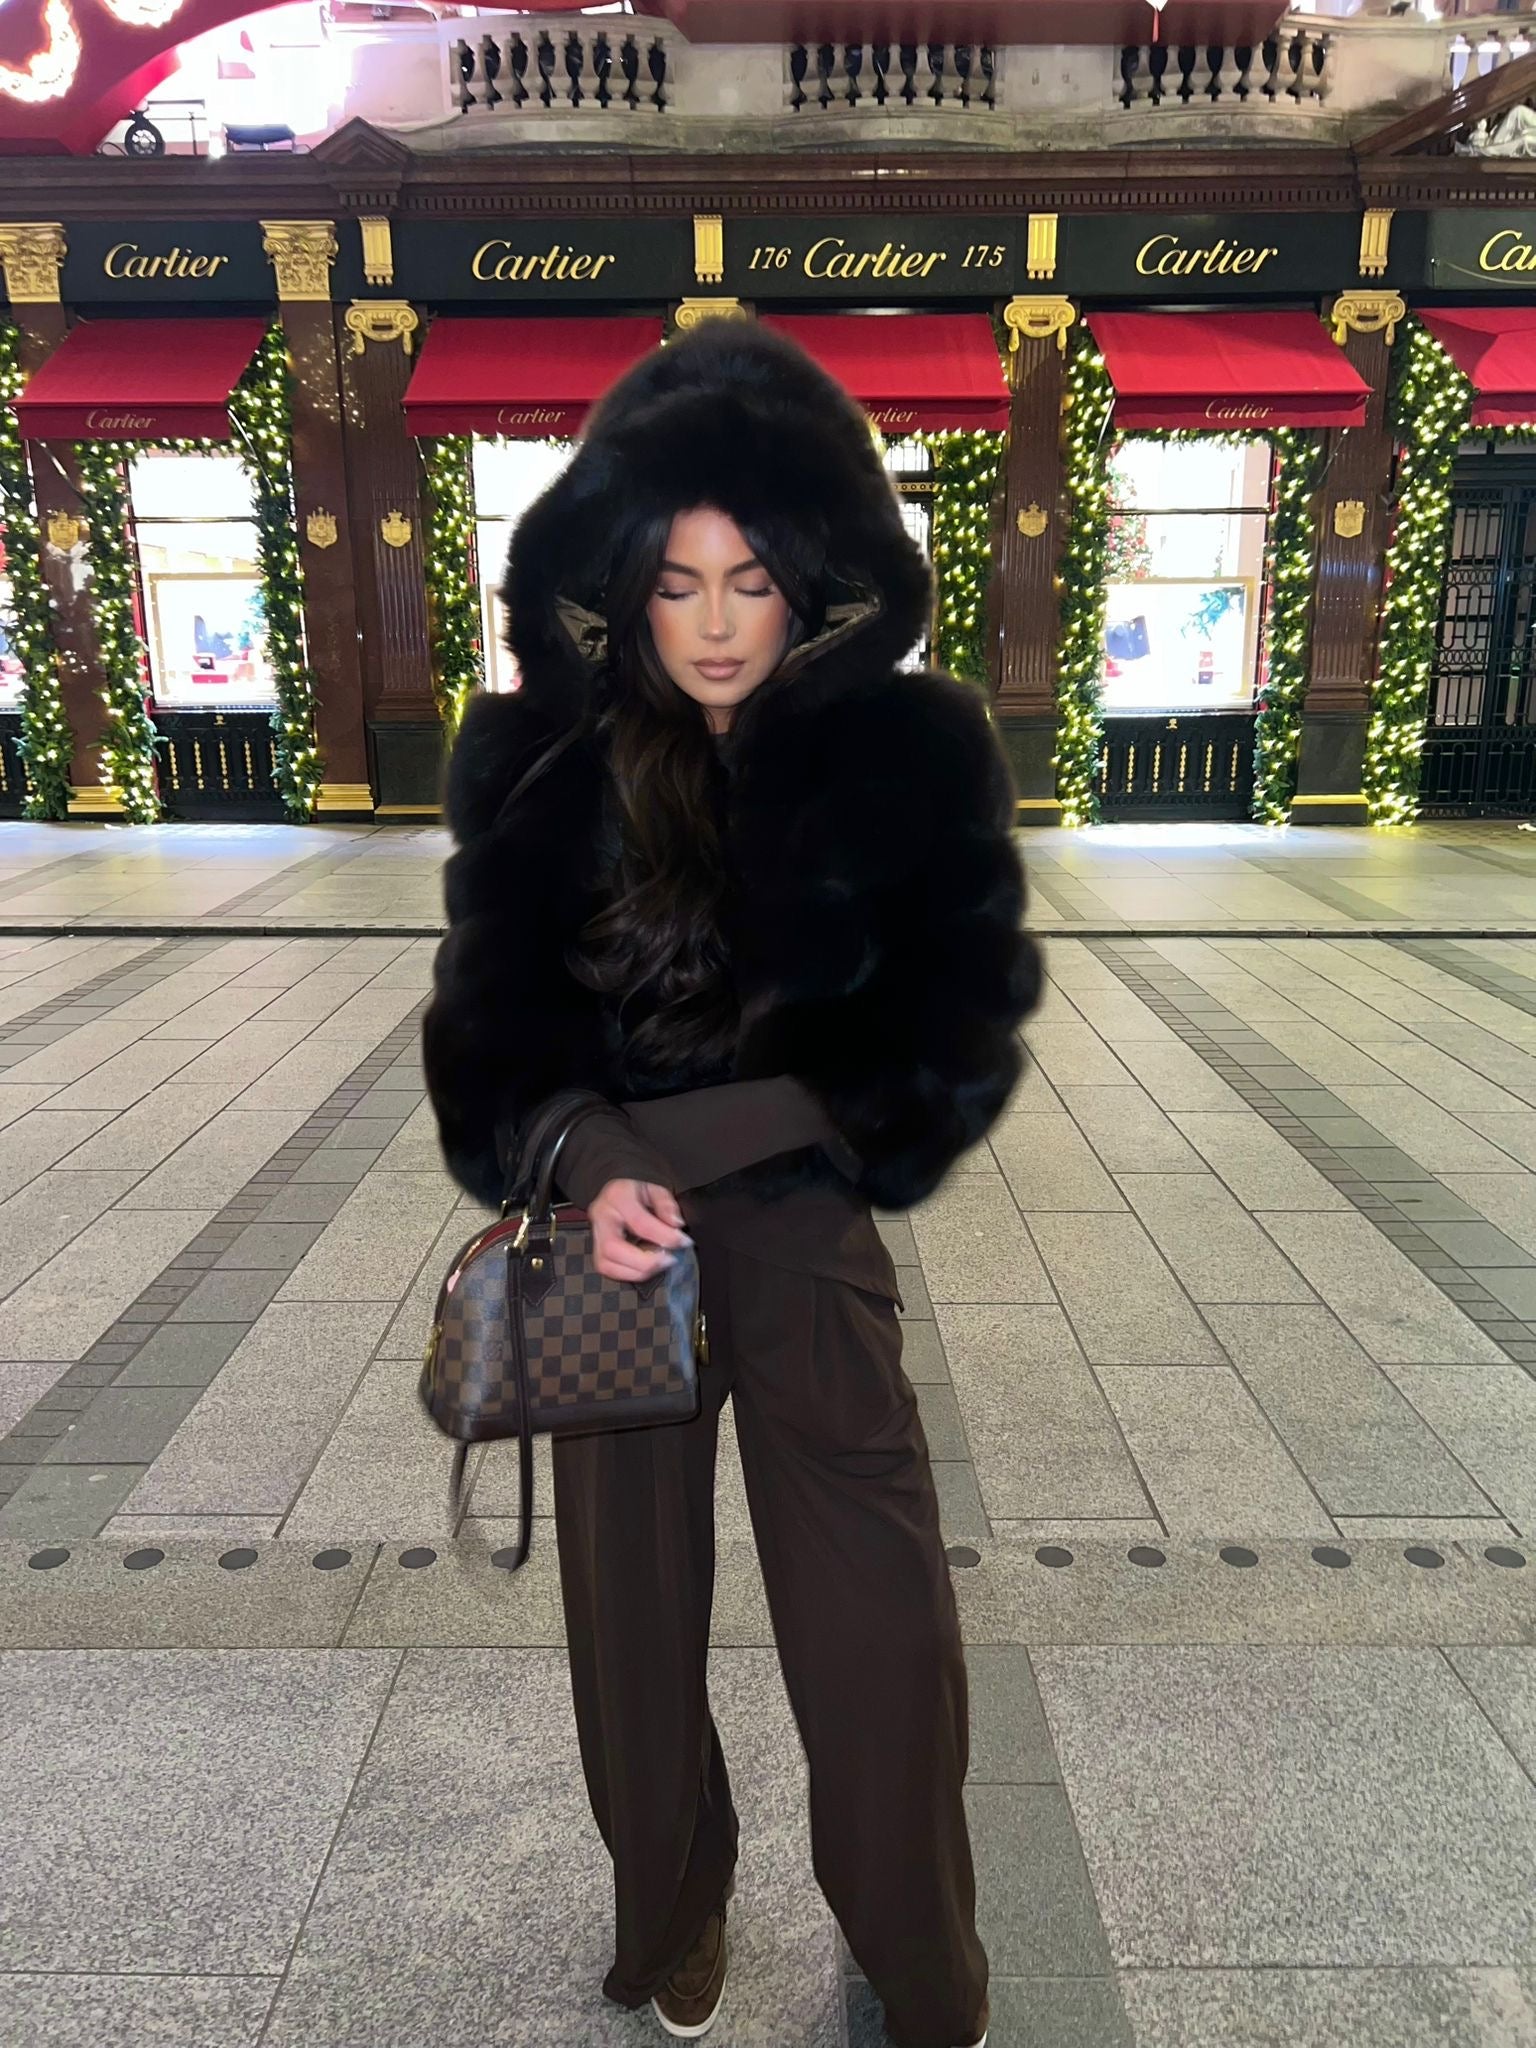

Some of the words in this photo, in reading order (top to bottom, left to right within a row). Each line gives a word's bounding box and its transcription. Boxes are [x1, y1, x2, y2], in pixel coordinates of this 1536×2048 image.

[103, 242, 229, 278] Cartier
[472, 239, 616, 281] Cartier
[748, 246, 792, 270] 176
[803, 237, 947, 278] Cartier
[961, 245, 1006, 268] 175
[1135, 233, 1278, 275] Cartier
[85, 409, 157, 429] Cartier
[497, 407, 566, 424] Cartier
[863, 404, 918, 423] artier
[1205, 399, 1273, 419] Cartier
